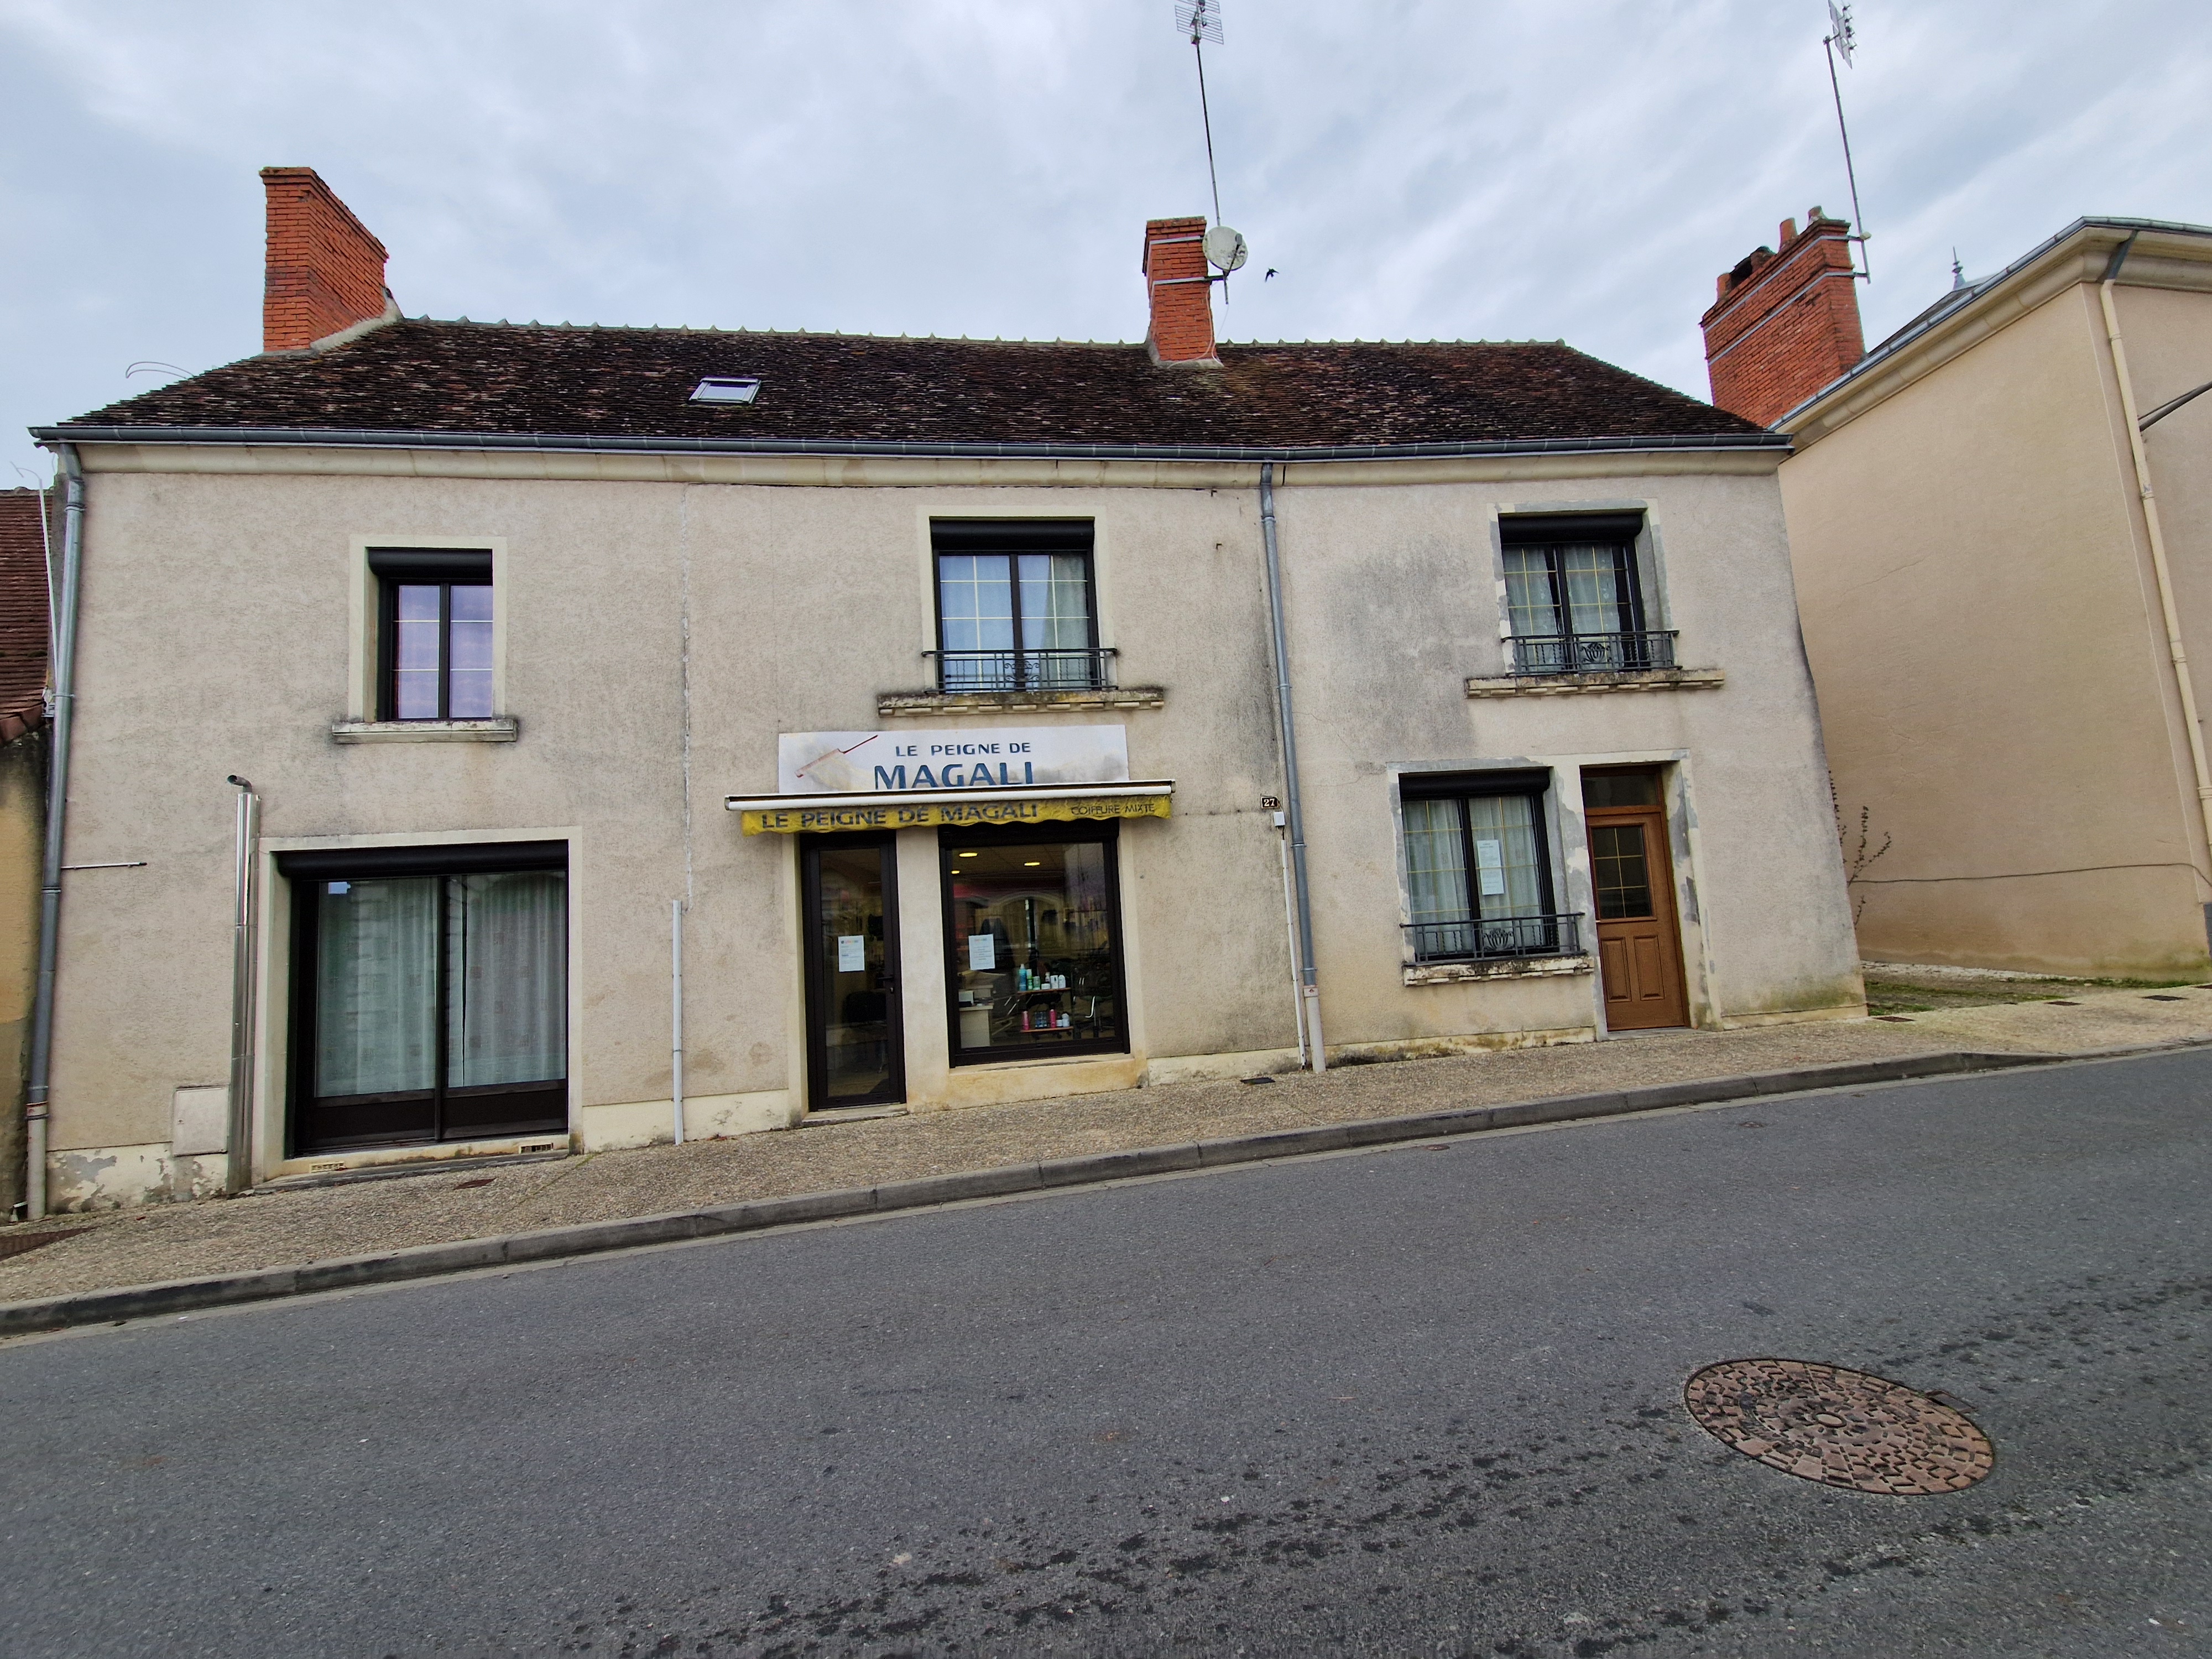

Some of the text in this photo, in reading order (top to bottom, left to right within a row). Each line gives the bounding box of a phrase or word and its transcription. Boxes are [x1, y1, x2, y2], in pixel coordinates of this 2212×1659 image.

[895, 743, 1031, 757] LE PEIGNE DE
[874, 761, 1034, 790] MAGALI
[1264, 798, 1275, 807] 27
[761, 804, 1156, 829] LE PEIGNE DE MAGALI COIFFURE MIXTE
